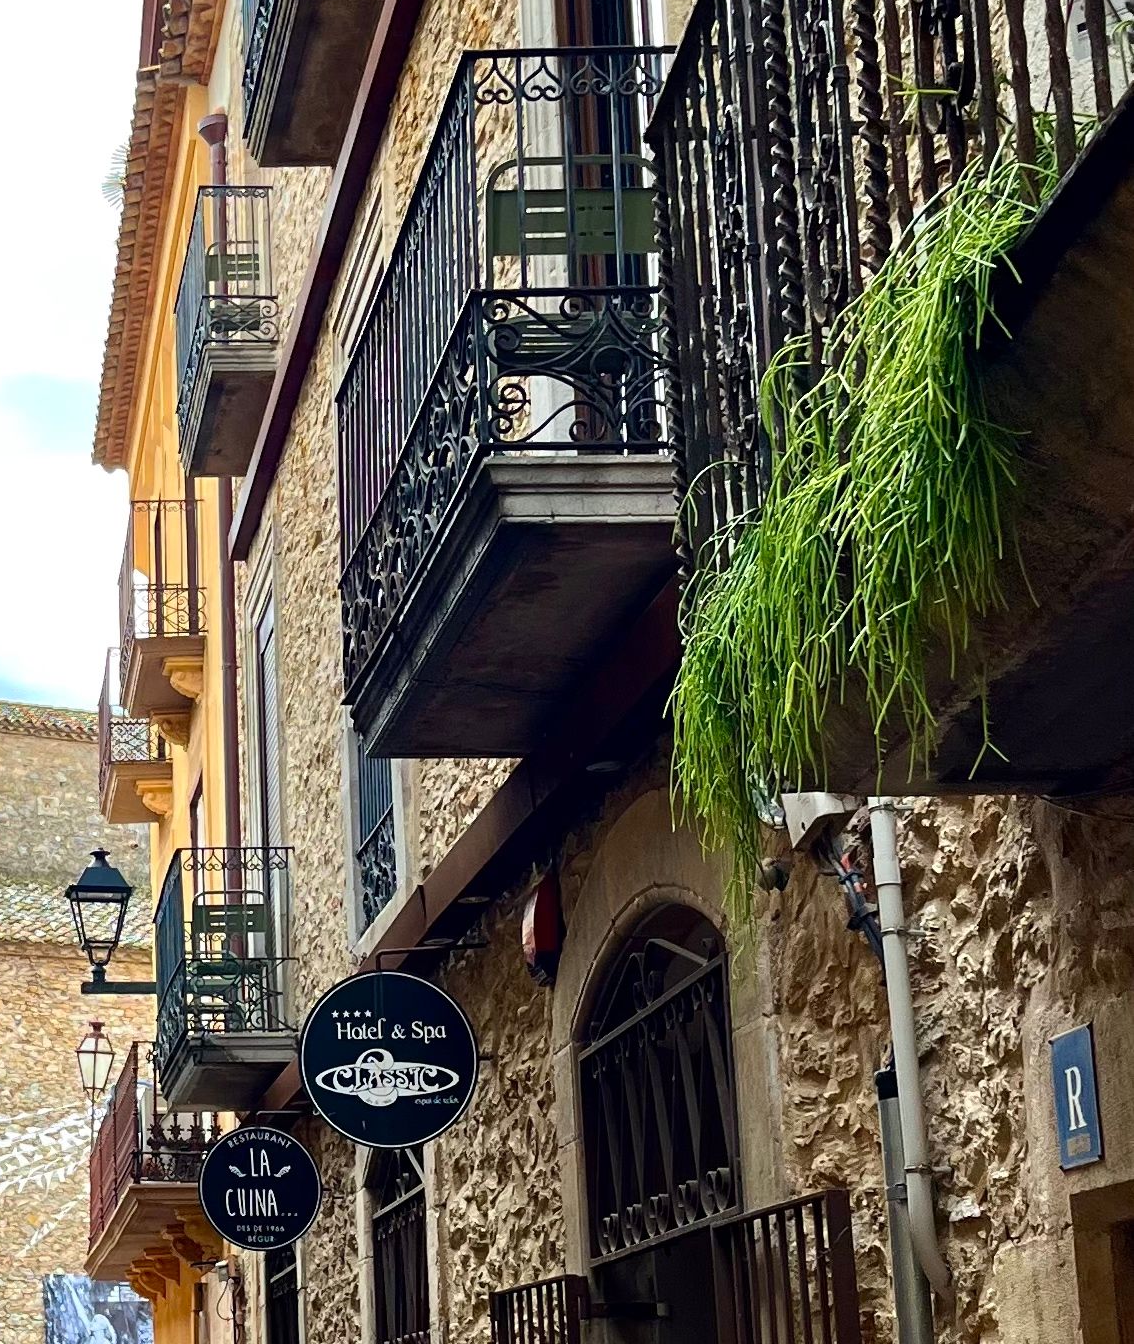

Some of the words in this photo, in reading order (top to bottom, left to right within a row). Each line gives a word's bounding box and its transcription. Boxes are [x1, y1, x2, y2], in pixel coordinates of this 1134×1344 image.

[336, 1017, 387, 1040] Hotel
[391, 1023, 407, 1040] &
[411, 1020, 447, 1044] Spa
[332, 1065, 440, 1093] CLASSIC
[1064, 1065, 1088, 1131] R
[226, 1131, 293, 1149] RESTAURANT
[249, 1147, 271, 1177] LA
